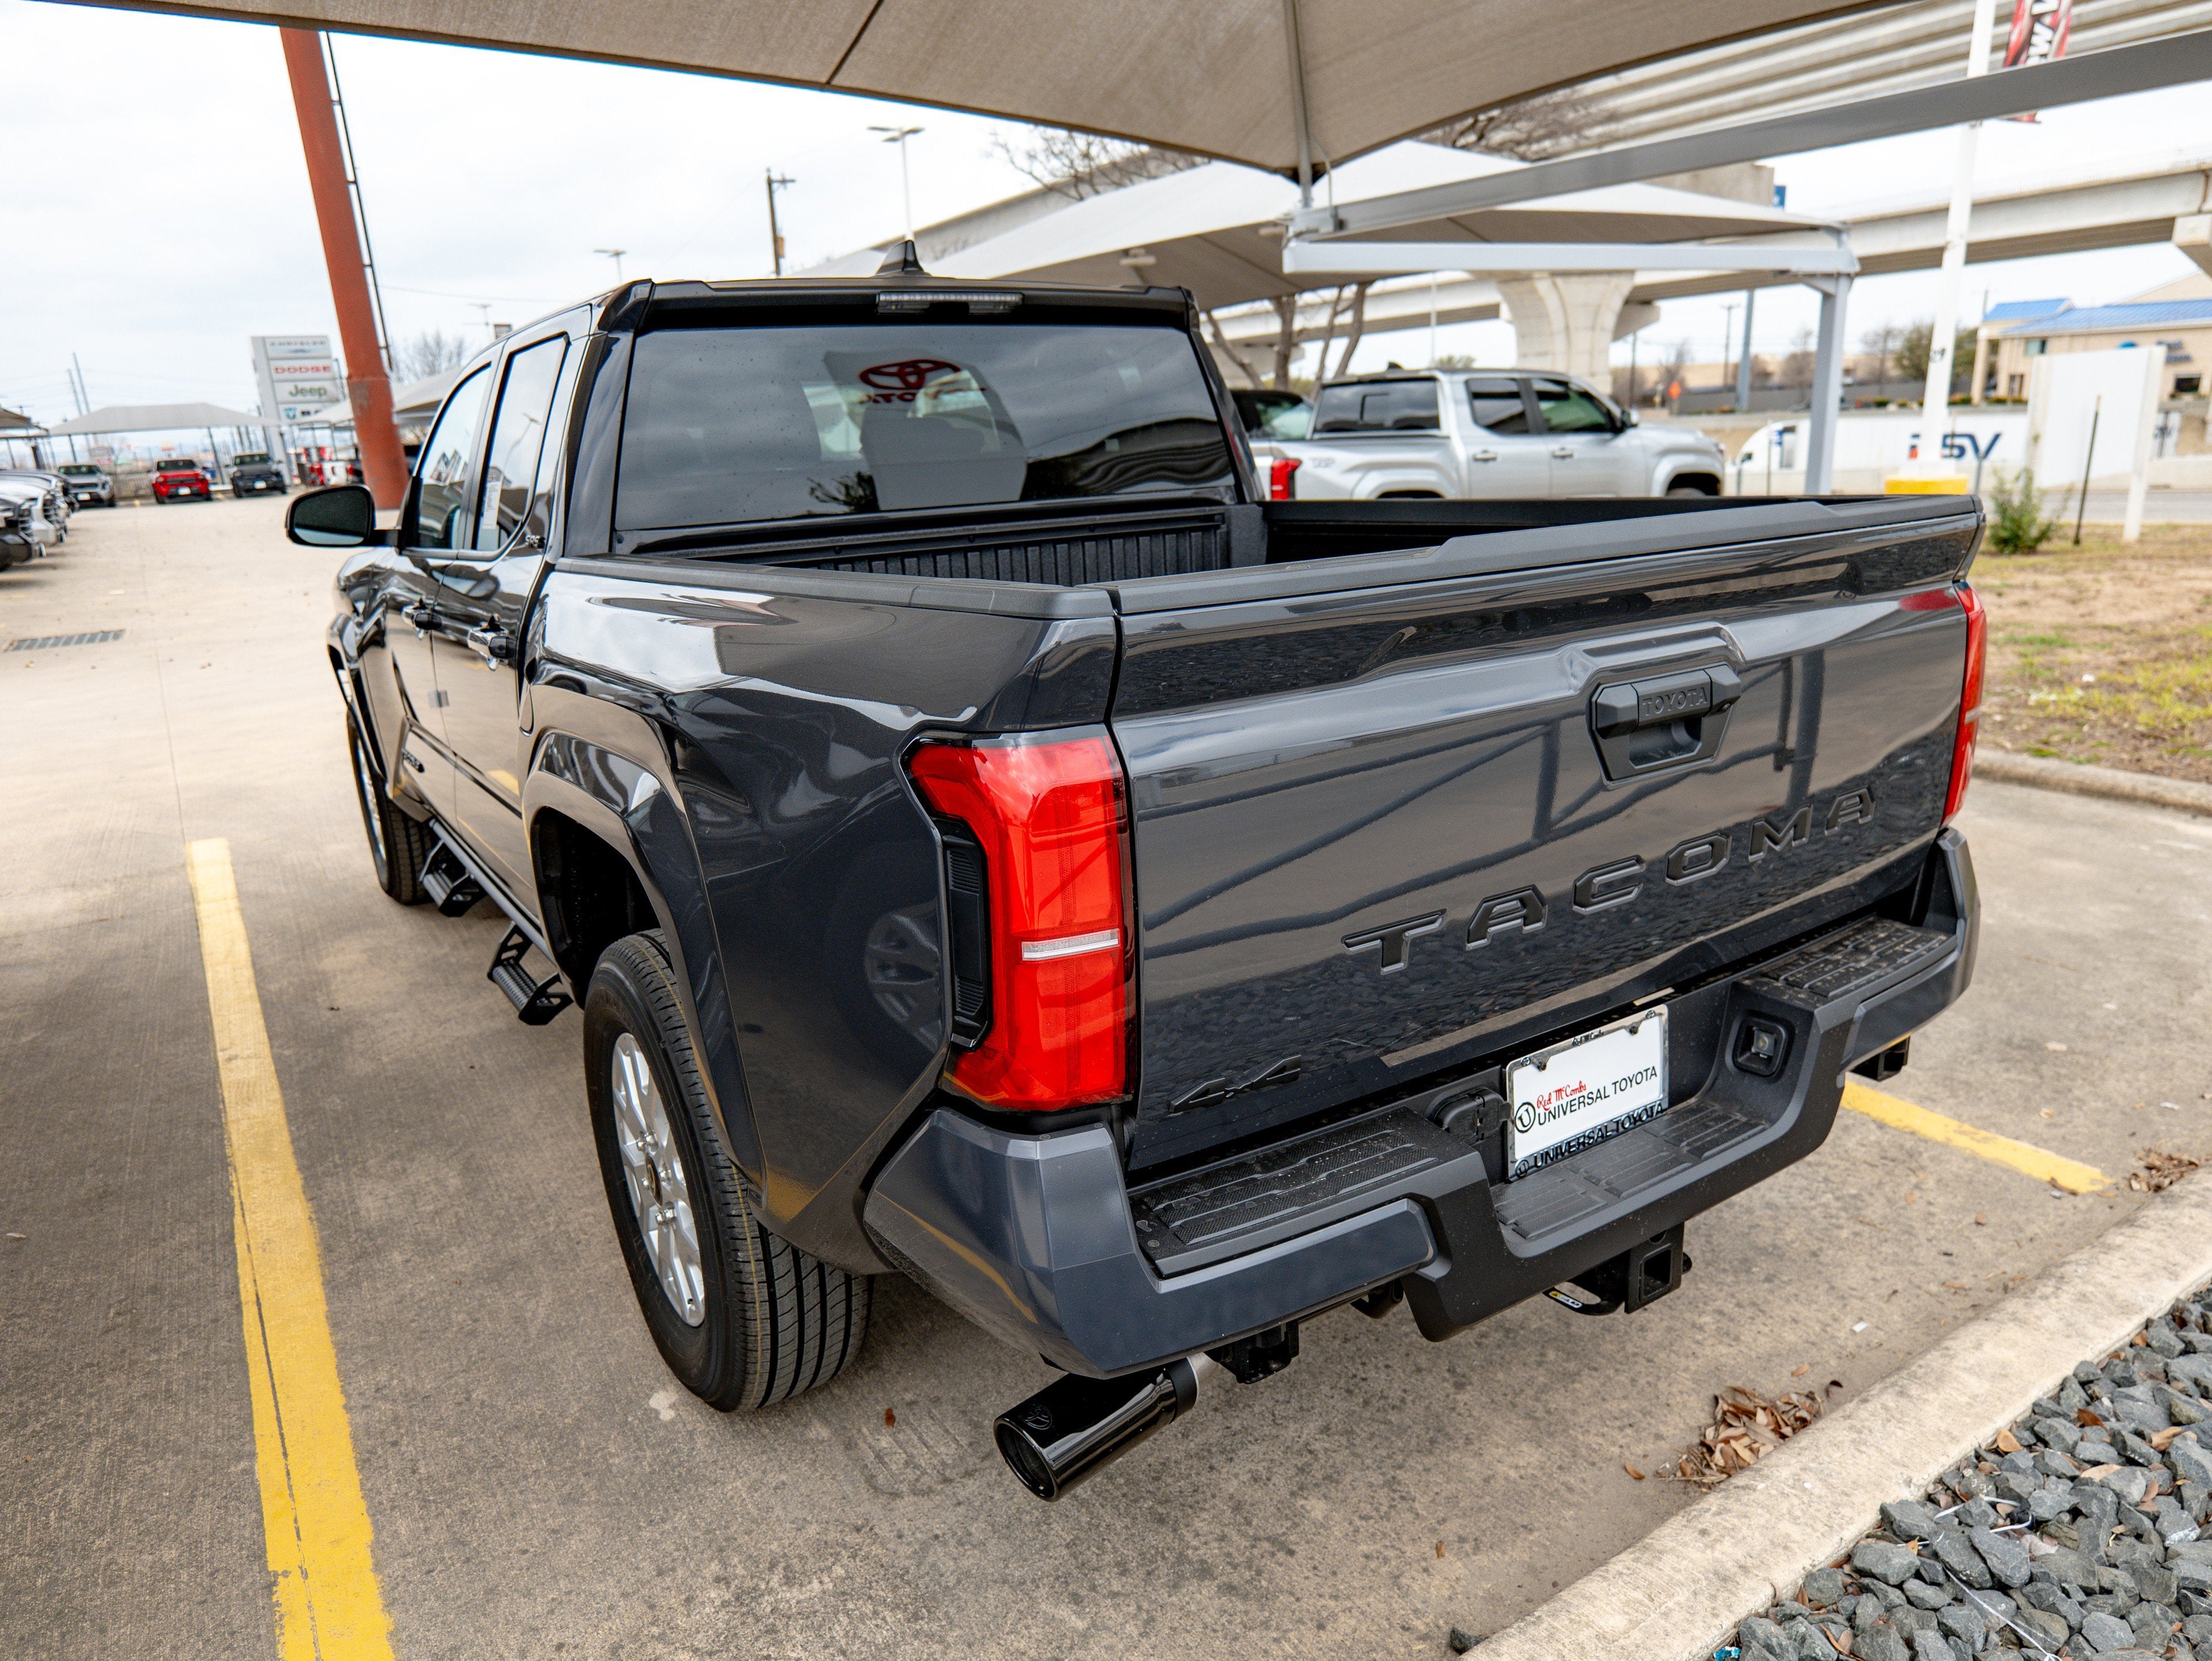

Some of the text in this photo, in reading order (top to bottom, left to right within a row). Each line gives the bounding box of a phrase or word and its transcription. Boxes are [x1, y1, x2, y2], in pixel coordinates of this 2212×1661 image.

[274, 366, 332, 374] DODGE
[288, 384, 327, 397] Jeep
[1642, 687, 1707, 717] TOYOTA
[1341, 785, 1876, 975] TACOMA
[1536, 1080, 1586, 1111] Red McCombs
[1537, 1065, 1658, 1126] UNIVERSAL TOYOTA
[1533, 1100, 1664, 1168] UNIVERSAL TOYOTA
